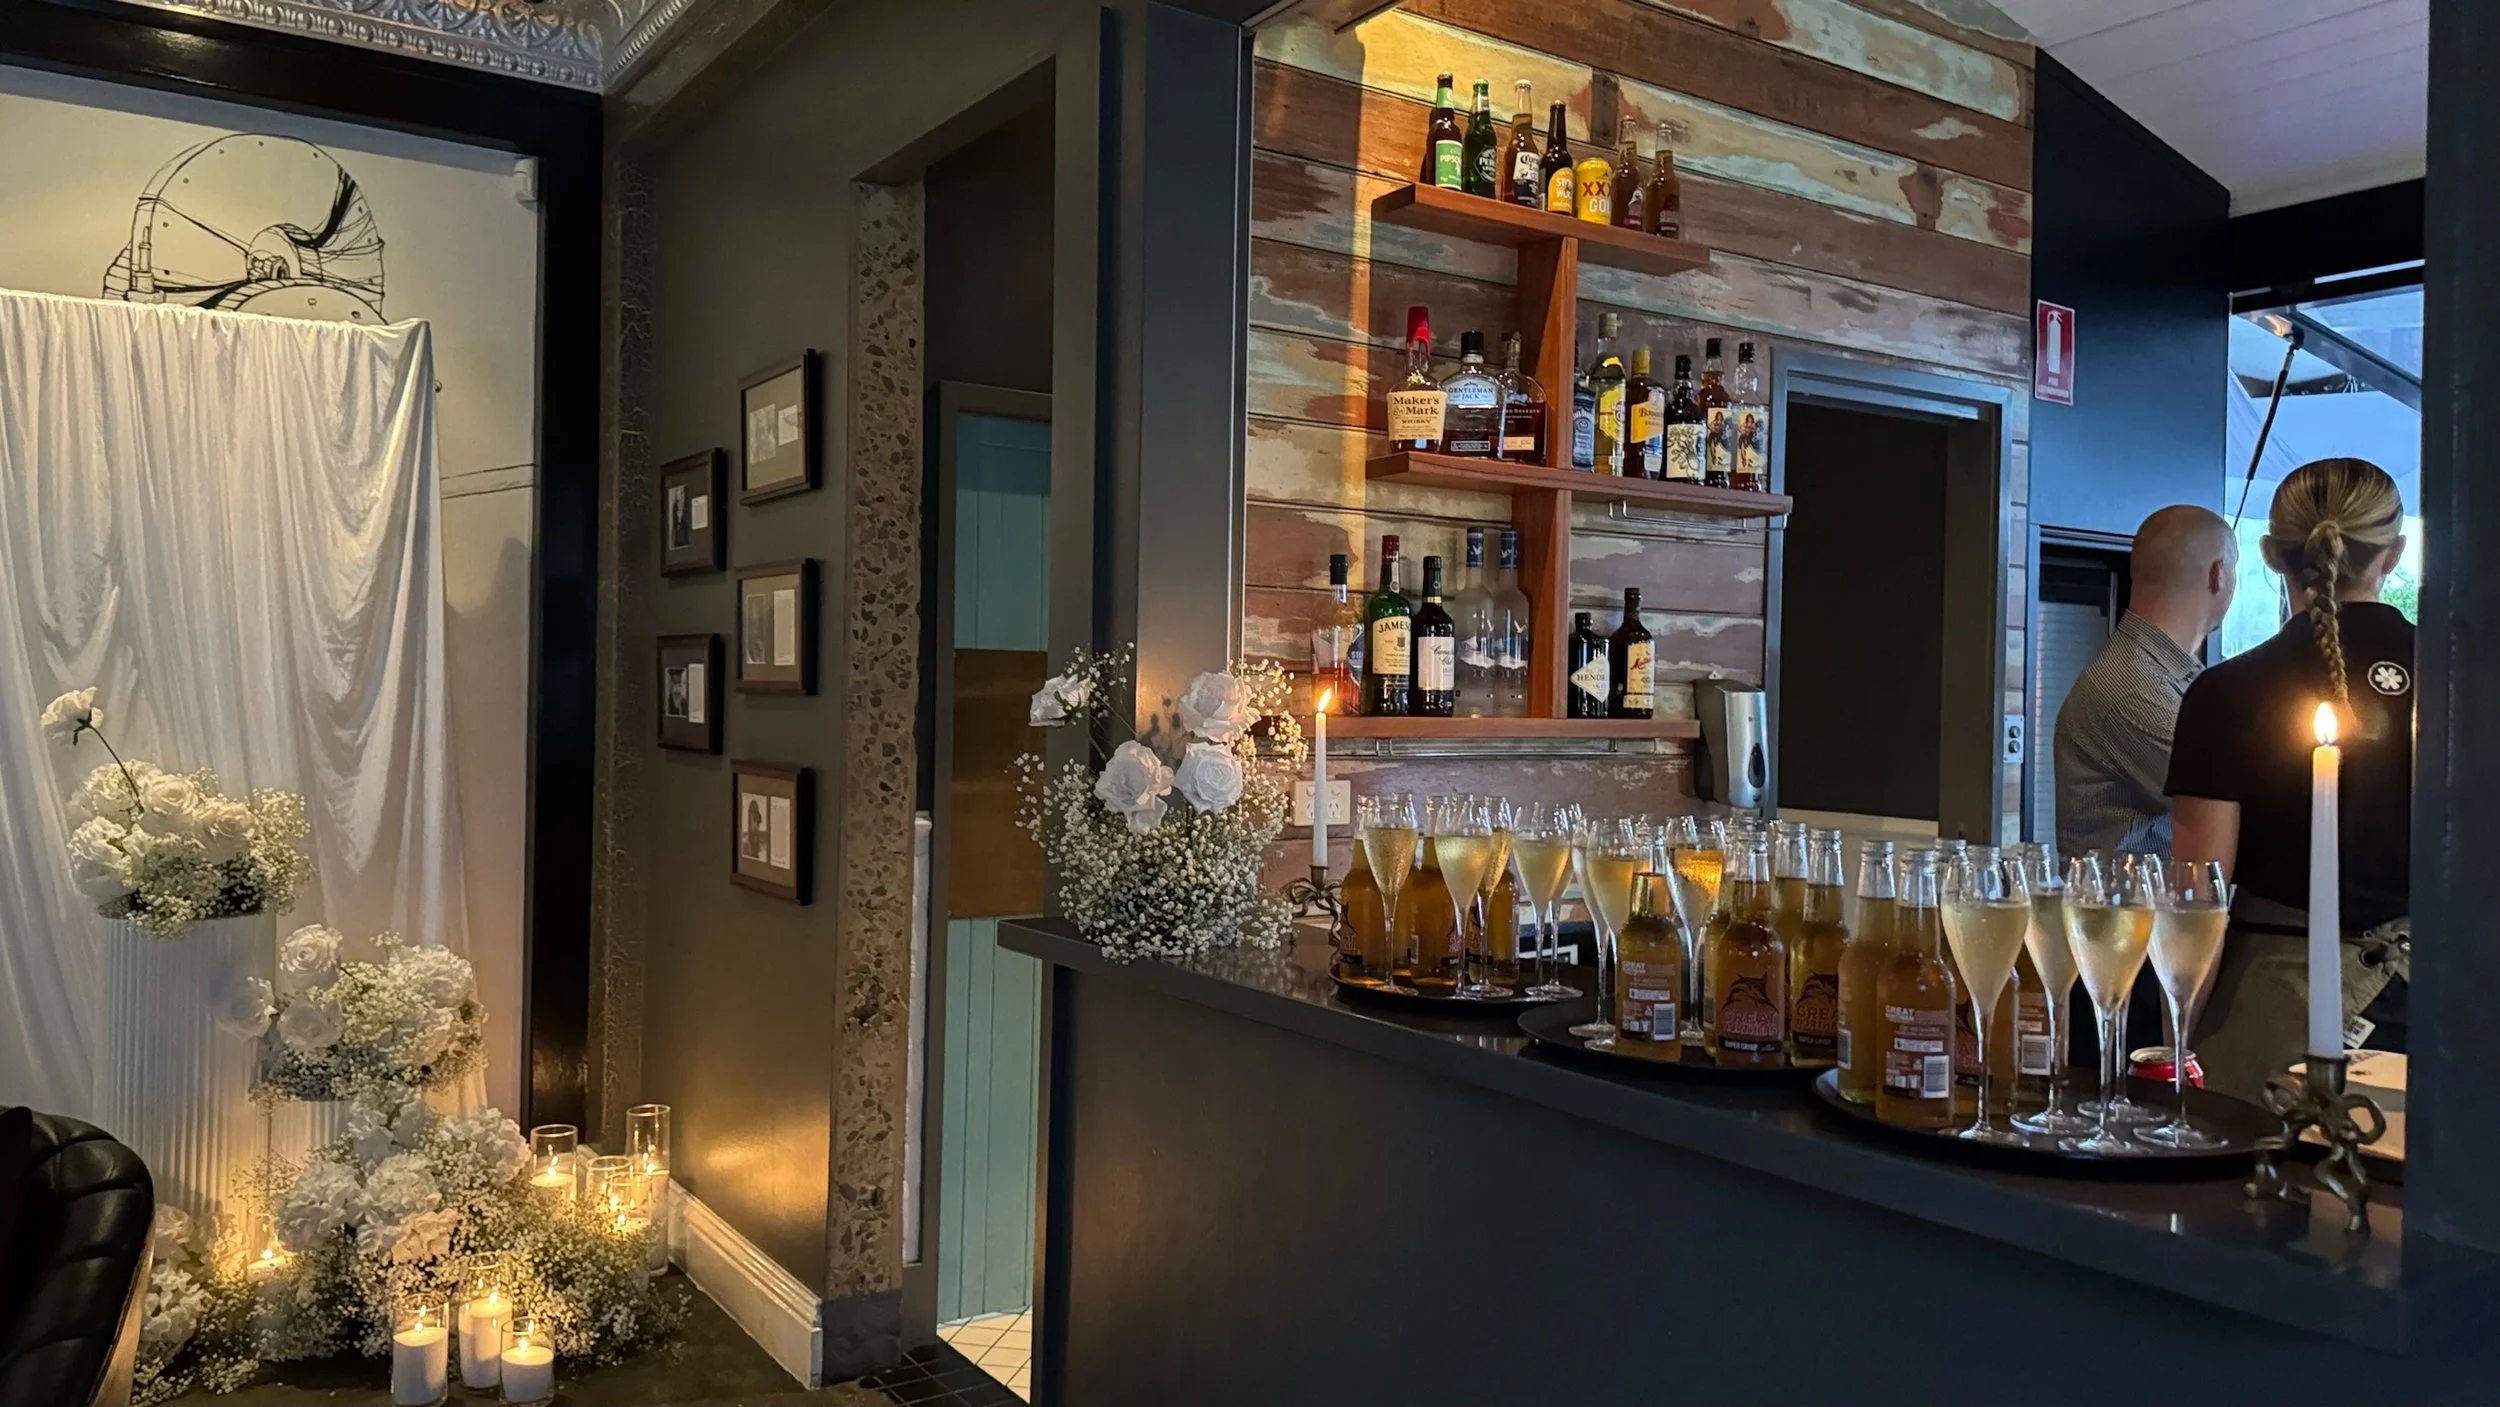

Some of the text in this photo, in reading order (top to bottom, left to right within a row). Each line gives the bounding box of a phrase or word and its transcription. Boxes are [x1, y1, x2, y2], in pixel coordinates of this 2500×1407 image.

[1393, 396, 1440, 405] Maker's
[1405, 406, 1439, 415] Mark
[1725, 1041, 1740, 1049] SUPER
